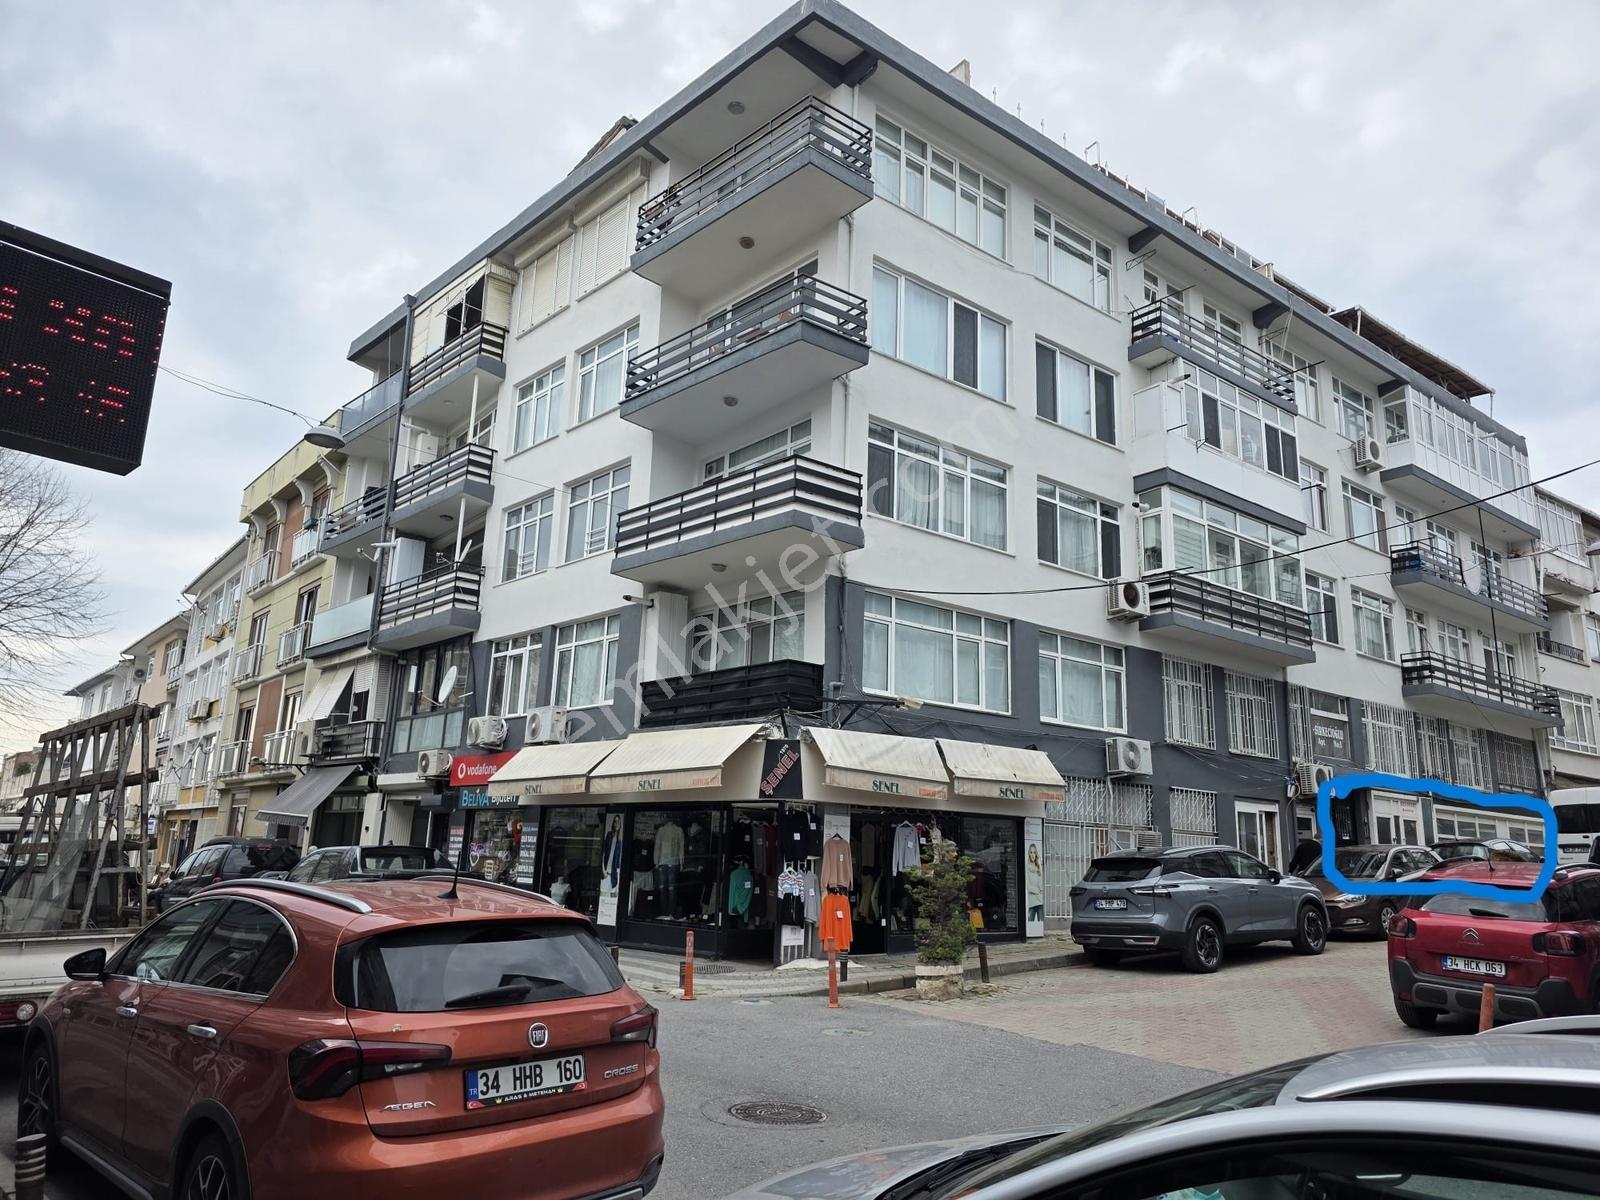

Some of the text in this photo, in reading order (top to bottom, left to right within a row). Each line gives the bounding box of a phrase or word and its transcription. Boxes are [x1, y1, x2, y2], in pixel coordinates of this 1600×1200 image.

[466, 763, 497, 776] vodafone
[761, 750, 800, 796] ŞENEL
[1447, 957, 1503, 973] 34 HCK 063
[479, 1058, 582, 1096] 34 HHB 160
[603, 1063, 640, 1080] CROSS
[469, 1088, 478, 1096] TR
